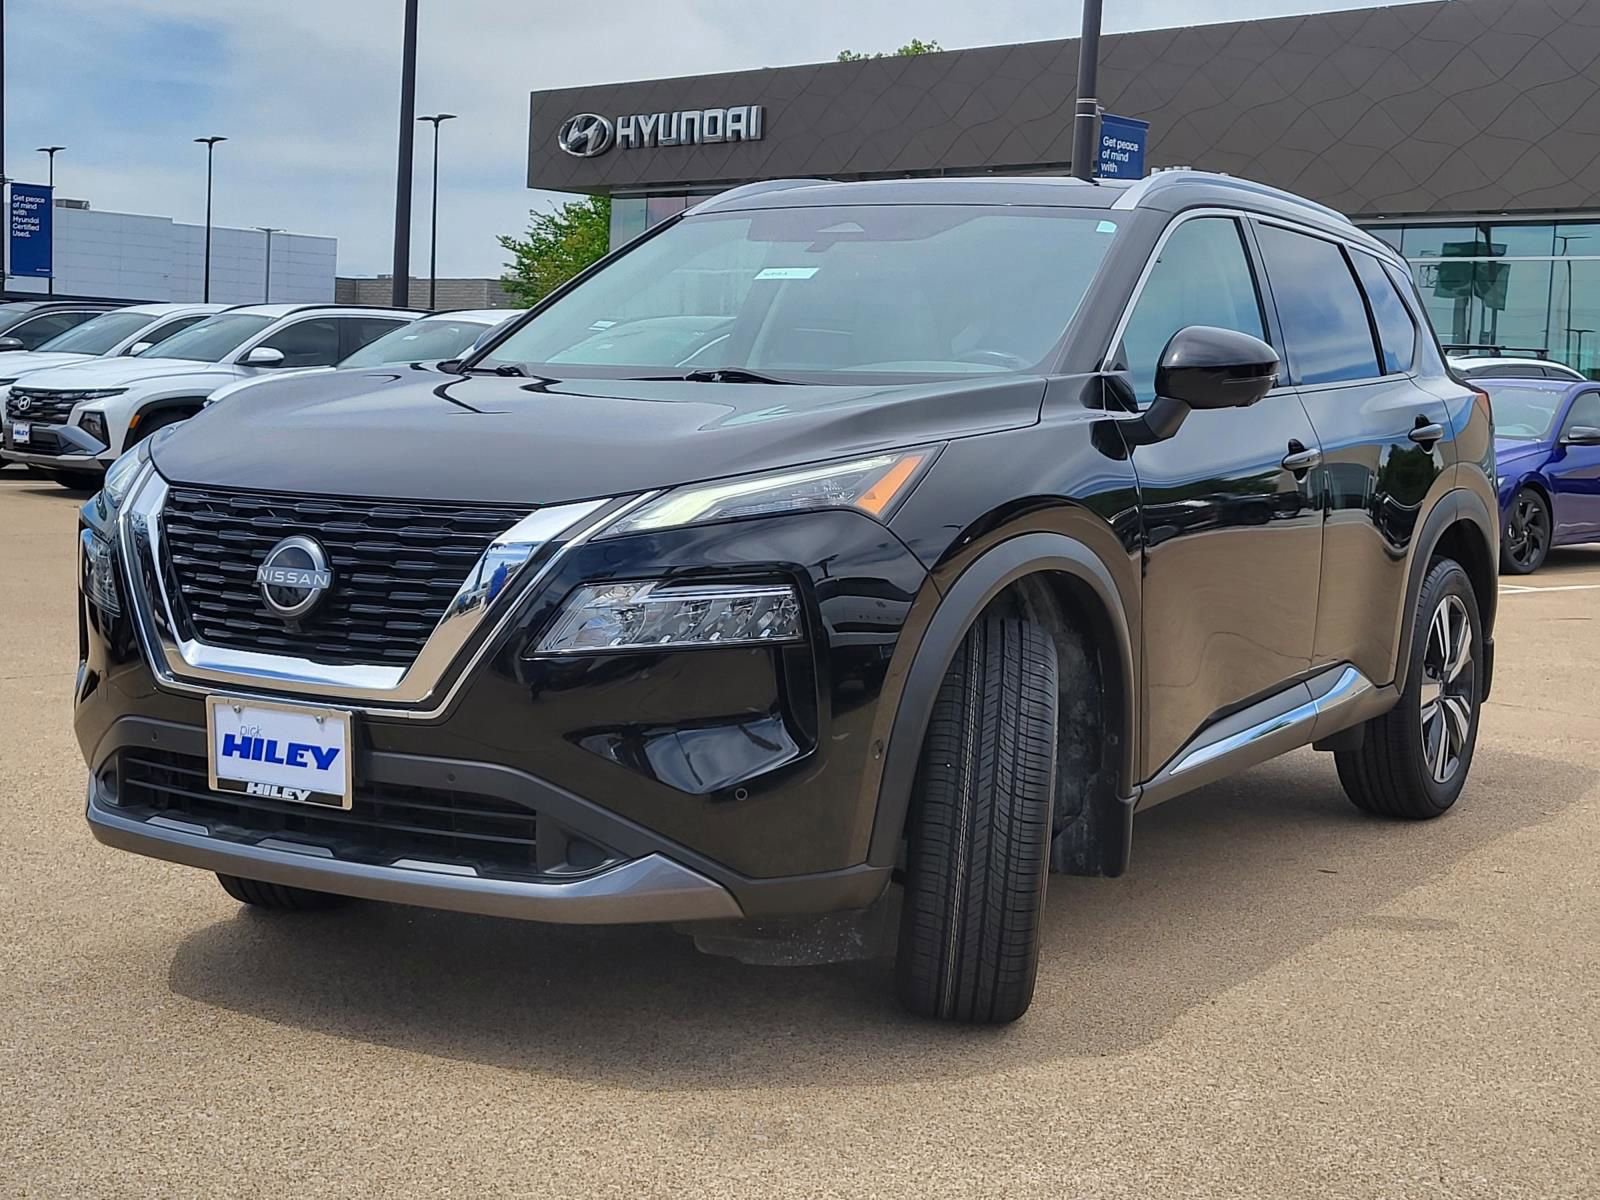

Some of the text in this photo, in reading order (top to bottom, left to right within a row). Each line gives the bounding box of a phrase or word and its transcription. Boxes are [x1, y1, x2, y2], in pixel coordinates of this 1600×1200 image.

[616, 105, 762, 149] HYUNDAI
[1103, 136, 1139, 152] Get peace
[1102, 149, 1129, 163] of mind
[1101, 161, 1118, 173] with
[12, 194, 46, 204] Get peace
[20, 202, 38, 210] mind
[12, 209, 28, 217] with
[12, 216, 40, 225] Hyundai
[12, 223, 40, 232] Certified
[12, 230, 32, 238] Used.
[258, 569, 328, 586] NISSAN
[222, 733, 340, 771] HILEY
[246, 782, 312, 801] HILEY
